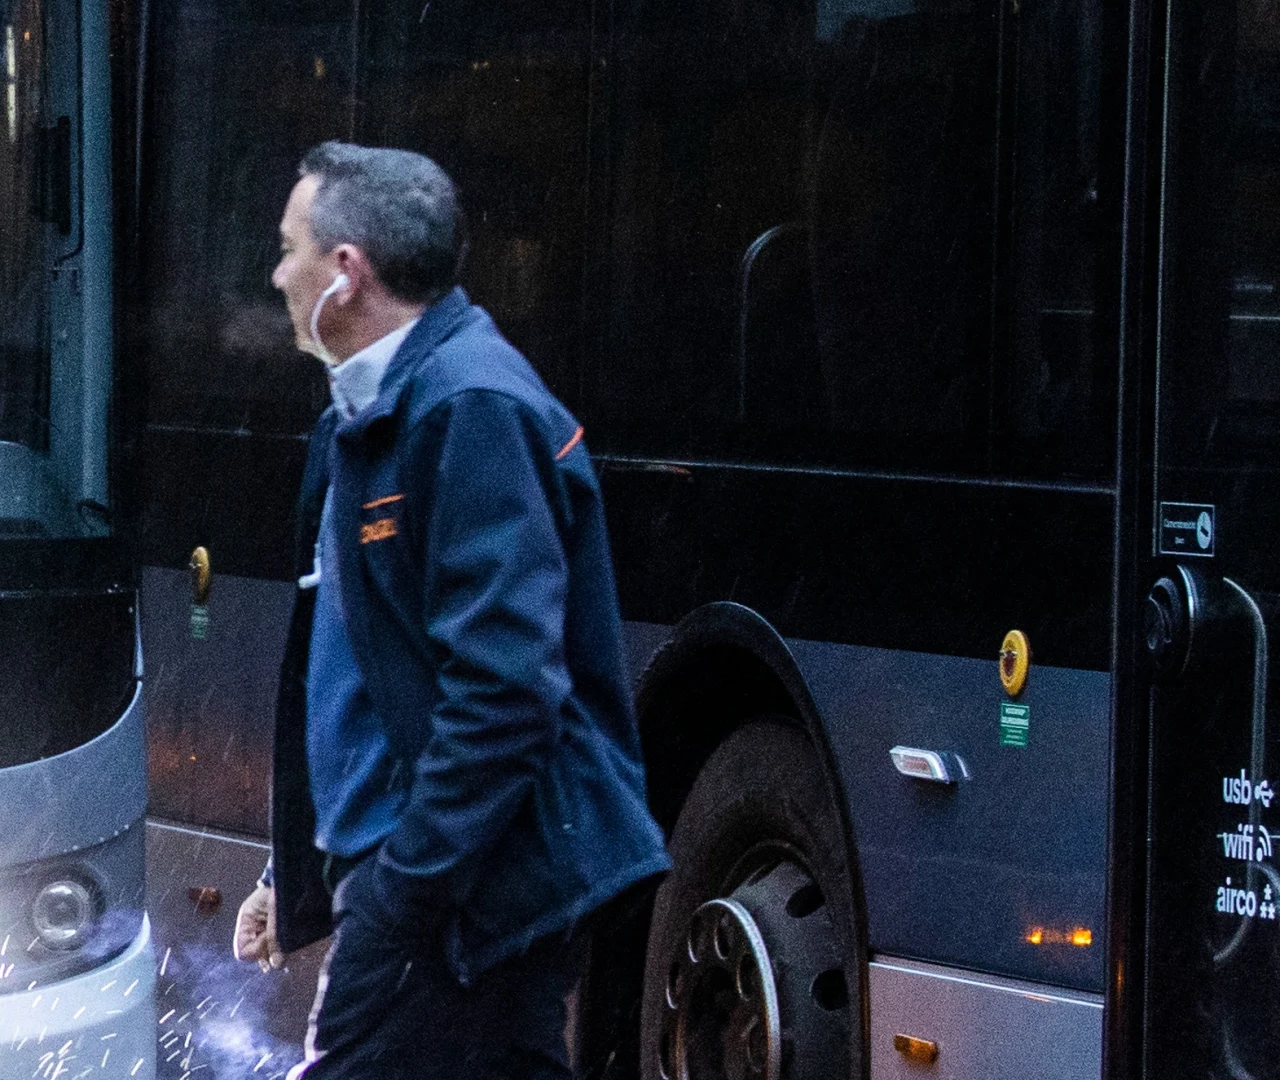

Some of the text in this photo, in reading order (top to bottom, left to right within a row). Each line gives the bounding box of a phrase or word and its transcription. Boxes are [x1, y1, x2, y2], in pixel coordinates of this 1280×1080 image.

[1223, 769, 1251, 805] usb
[1222, 823, 1253, 861] wifi
[1216, 877, 1257, 917] airco
